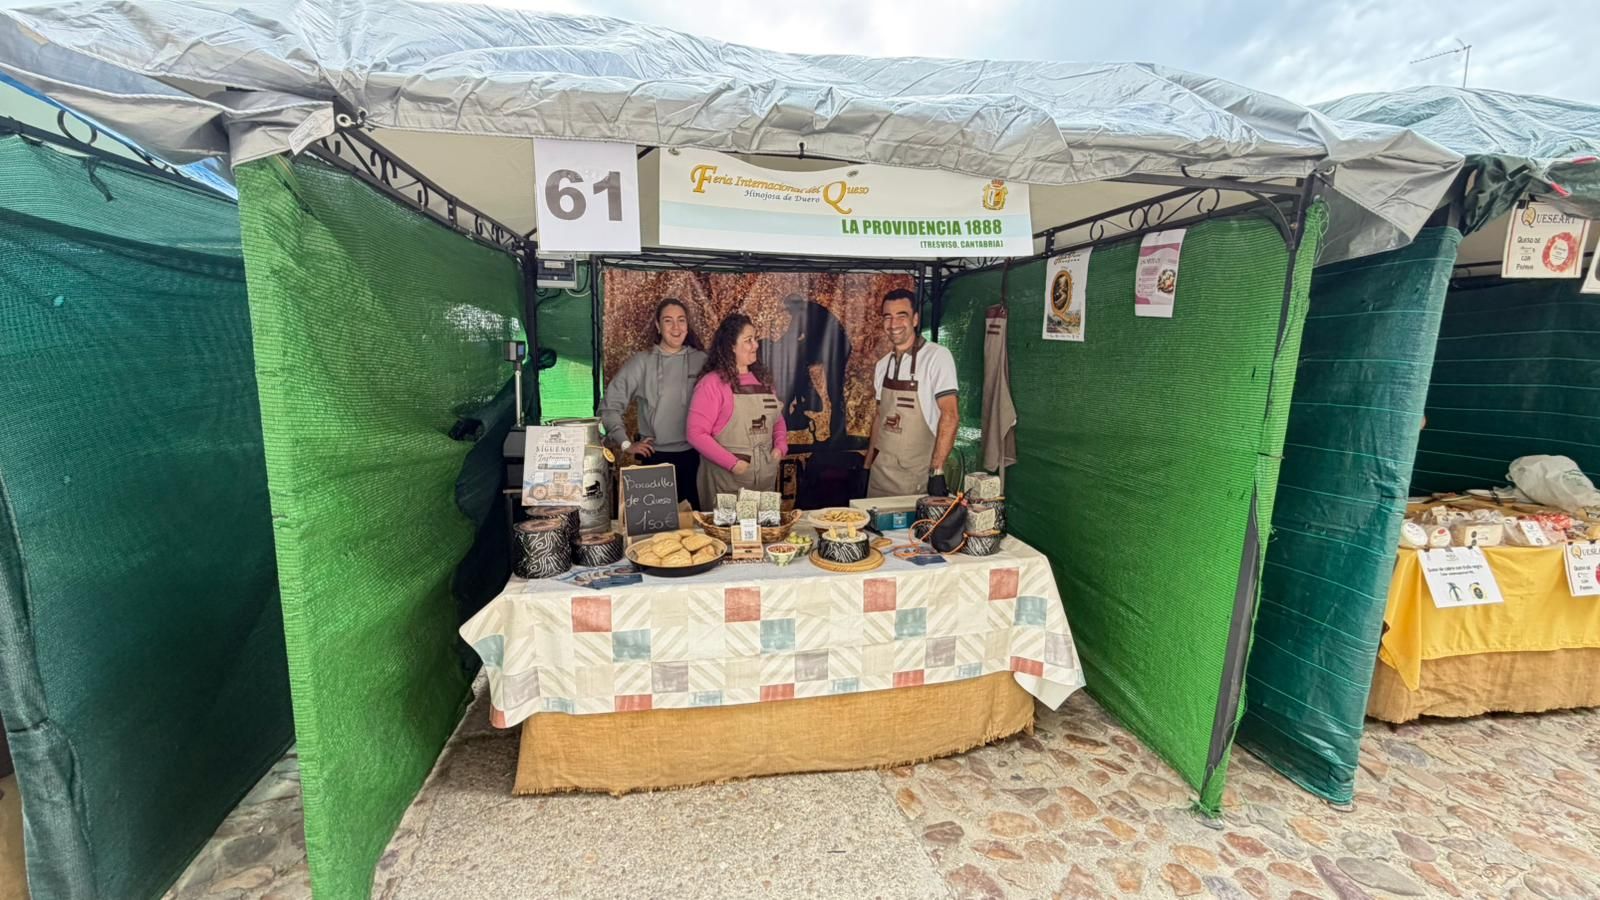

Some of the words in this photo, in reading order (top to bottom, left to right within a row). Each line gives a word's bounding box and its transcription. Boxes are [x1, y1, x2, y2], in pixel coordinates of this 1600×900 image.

[545, 169, 622, 221] 61
[690, 164, 734, 194] Feria
[823, 180, 869, 215] Queso
[744, 189, 781, 201] Hinojosa
[782, 193, 793, 202] de
[794, 194, 821, 204] Duero
[841, 218, 860, 234] LA
[862, 219, 962, 236] PROVIDENCIA
[964, 219, 1002, 235] 1888
[961, 240, 1004, 249] CANTABRIA)
[623, 475, 674, 491] Bocadillo
[625, 494, 640, 508] de
[642, 493, 672, 506] Queso
